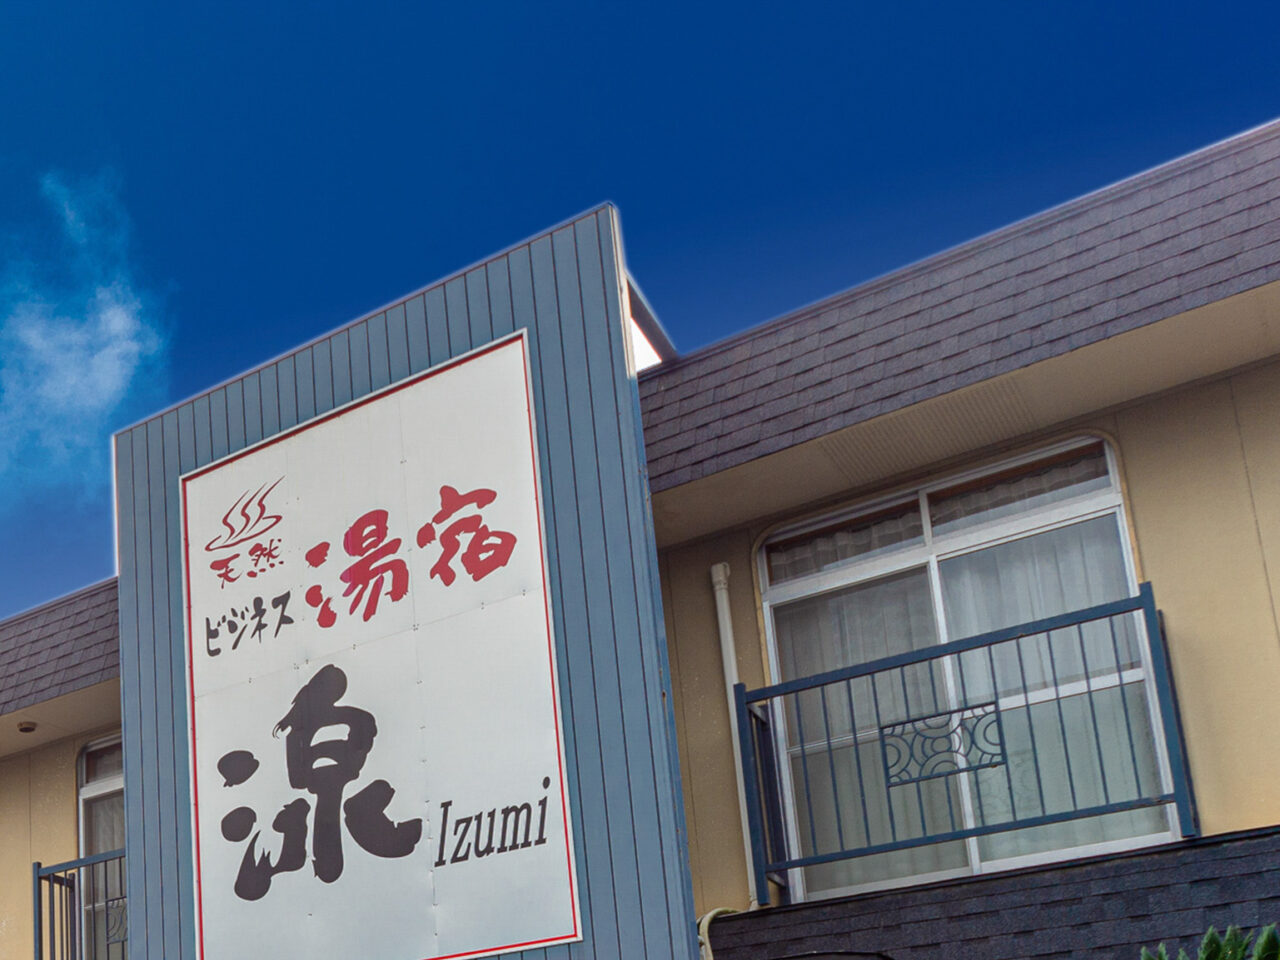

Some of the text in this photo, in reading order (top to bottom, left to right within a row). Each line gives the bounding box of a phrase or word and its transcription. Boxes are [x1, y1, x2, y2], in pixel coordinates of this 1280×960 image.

[210, 538, 284, 589] 天然
[305, 485, 518, 629] 湯宿
[206, 590, 294, 657] ビジネス
[434, 776, 551, 868] Izumi
